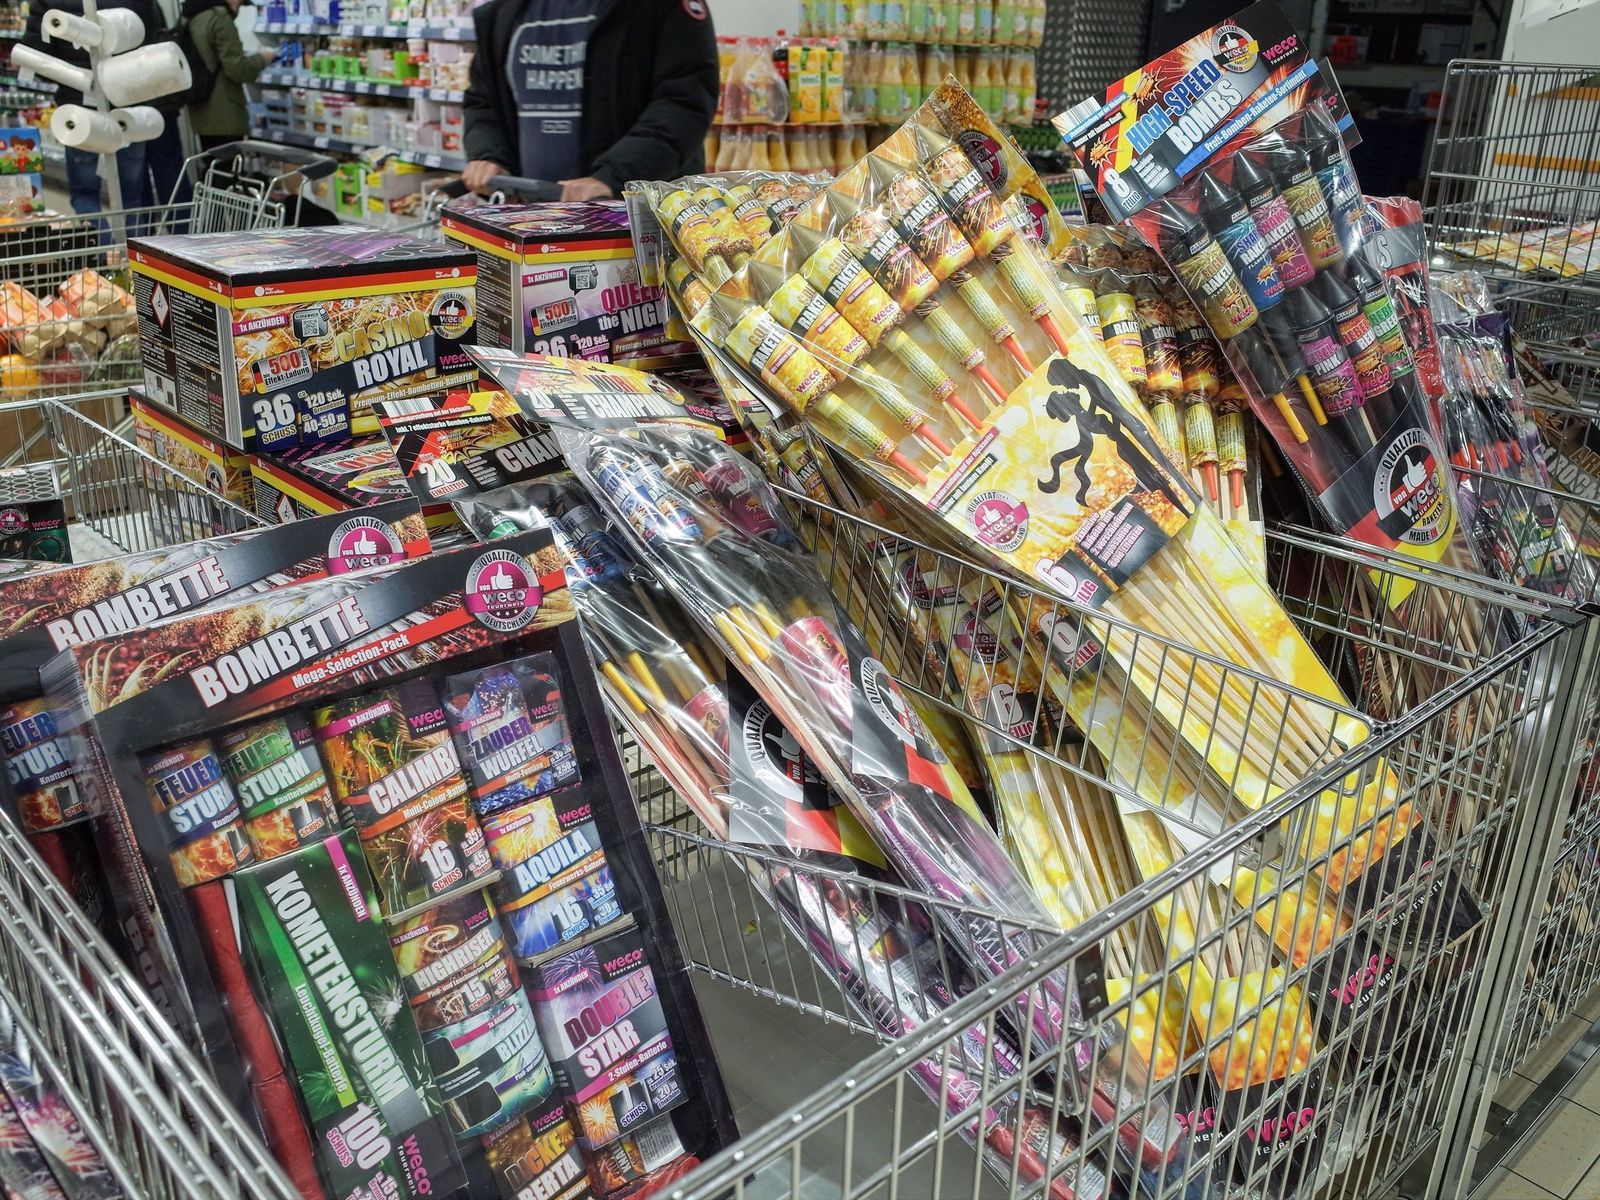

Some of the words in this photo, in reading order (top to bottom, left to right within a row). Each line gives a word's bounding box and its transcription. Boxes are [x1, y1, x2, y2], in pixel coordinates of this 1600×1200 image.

[1262, 35, 1297, 60] weco
[1271, 46, 1299, 65] feuerwerk
[1125, 57, 1223, 155] HIGH-SPEED
[1166, 78, 1243, 155] BOMBS
[1203, 70, 1307, 153] Profi-Bomben-Raketen-Sortiment
[1103, 167, 1130, 198] 8
[439, 315, 464, 325] weco
[544, 302, 570, 319] 500
[599, 313, 619, 331] the
[239, 324, 248, 333] 1x
[248, 315, 286, 331] ANZÜNDEN
[336, 309, 427, 363] CASINO
[533, 336, 569, 357] 36
[576, 336, 593, 349] 120
[593, 333, 609, 345] sek.
[264, 366, 310, 387] Effekt-Ladung
[269, 353, 301, 375] 500
[353, 340, 429, 389] ROYAL
[442, 362, 472, 370] feuerwerk
[1314, 353, 1341, 375] PINK
[354, 371, 474, 408] Premium-Effekt-Bombetten-Batterie
[796, 369, 820, 394] weco
[305, 393, 325, 409] 120
[326, 388, 345, 402] sek.
[521, 387, 555, 409] 20
[582, 394, 677, 418] CHAMPION
[253, 394, 296, 432] 36
[304, 416, 336, 433] 40-50
[336, 412, 346, 423] m
[685, 404, 716, 418] weco
[263, 425, 297, 444] SCHUSS
[419, 459, 457, 488] 20
[430, 479, 469, 498] EINZELTEILE
[1393, 490, 1408, 505] von
[1400, 472, 1440, 518] weco
[984, 513, 1014, 538] weco
[1097, 502, 1134, 551] verschiedenen
[1409, 531, 1430, 541] MADE
[345, 555, 390, 569] weco
[1035, 558, 1078, 602] 6
[45, 556, 231, 651] BOMBETTE
[482, 590, 526, 605] weco
[485, 613, 532, 630] DEUTSCHLAND
[189, 596, 371, 709] BOMBETTE
[291, 635, 412, 690] Mega-Selection-Pack
[348, 717, 357, 728] 1x
[356, 703, 391, 725] ANZÜNDEN
[470, 716, 533, 762] ZAUBER
[225, 732, 294, 780] FEUER
[480, 736, 544, 781] WÜRFEL
[61, 780, 82, 805] 7
[153, 754, 223, 808] FEUER
[237, 751, 311, 809] STURM
[169, 777, 235, 834] STURM
[289, 799, 313, 824] 7
[559, 804, 591, 823] weco
[300, 817, 325, 839] SCHUSS
[465, 829, 479, 844] 35
[421, 840, 456, 879] 16
[515, 829, 593, 894] AQUILA
[432, 868, 462, 893] SCHUSS
[341, 874, 366, 918] ANZÜNDEN
[465, 909, 488, 927] weco
[552, 896, 584, 930] 16
[400, 925, 429, 943] ANZÜNDEN
[562, 917, 590, 942] SCHUSS
[413, 928, 495, 991] HIGHRISER
[603, 949, 641, 973] weco
[609, 961, 642, 978] feuerwerk
[265, 870, 410, 1106] KOMETENSTURM
[461, 978, 487, 1003] 15
[560, 971, 589, 992] ANZÜNDEN
[564, 969, 654, 1049] DOUBLE
[295, 983, 347, 1093] Leuchtkugel-Batterie
[577, 1020, 640, 1078] STAR
[608, 1041, 668, 1081] 2-Stufen-Batterie
[652, 1064, 664, 1080] 25
[615, 1084, 633, 1111] 7
[659, 1084, 671, 1098] 20
[533, 1106, 564, 1128] weco
[537, 1116, 564, 1132] feuerwerk
[621, 1103, 649, 1128] SCHUSS
[327, 1128, 353, 1168] SCHUSS
[338, 1102, 391, 1170] 100
[397, 1145, 417, 1196] feuerwerk
[404, 1133, 430, 1194] weco
[504, 1132, 567, 1191] DICKE
